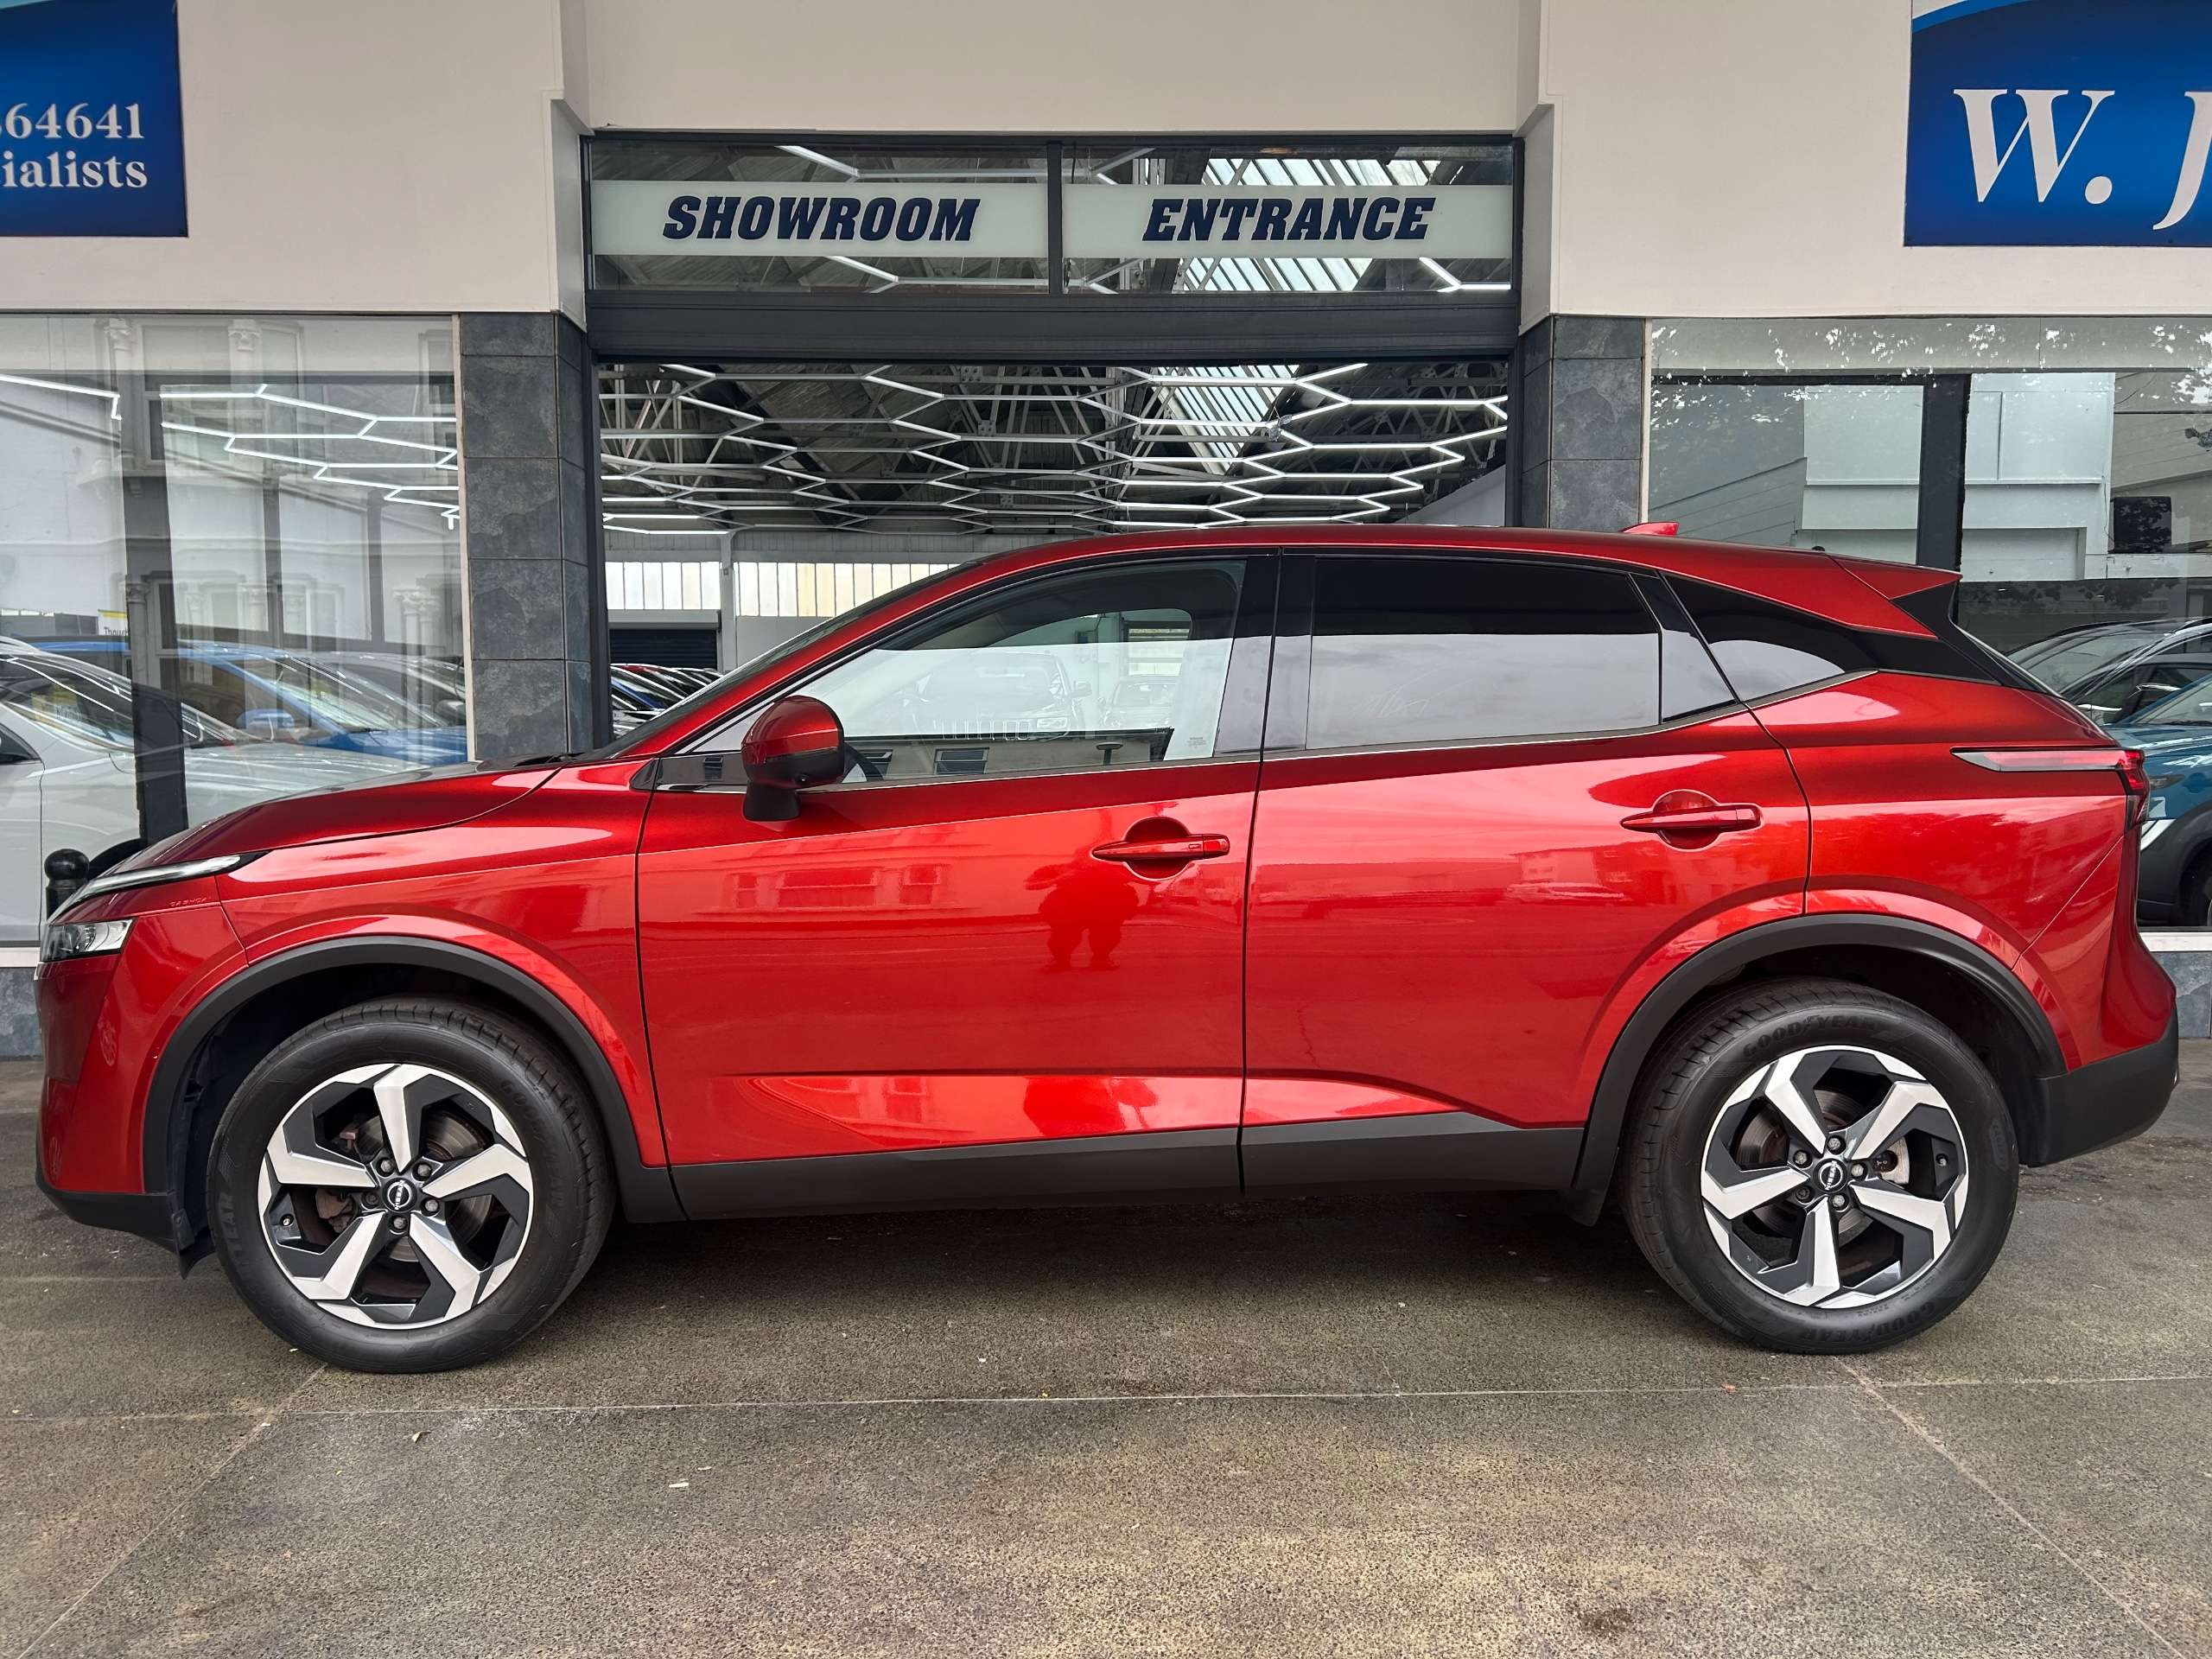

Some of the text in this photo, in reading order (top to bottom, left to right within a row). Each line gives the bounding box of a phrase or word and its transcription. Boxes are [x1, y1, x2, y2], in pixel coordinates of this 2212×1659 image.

[0, 103, 145, 139] 64641
[0, 149, 149, 188] ialists
[1953, 89, 2115, 205] W.
[662, 195, 1436, 242] SHOWROOM ENTRANCE
